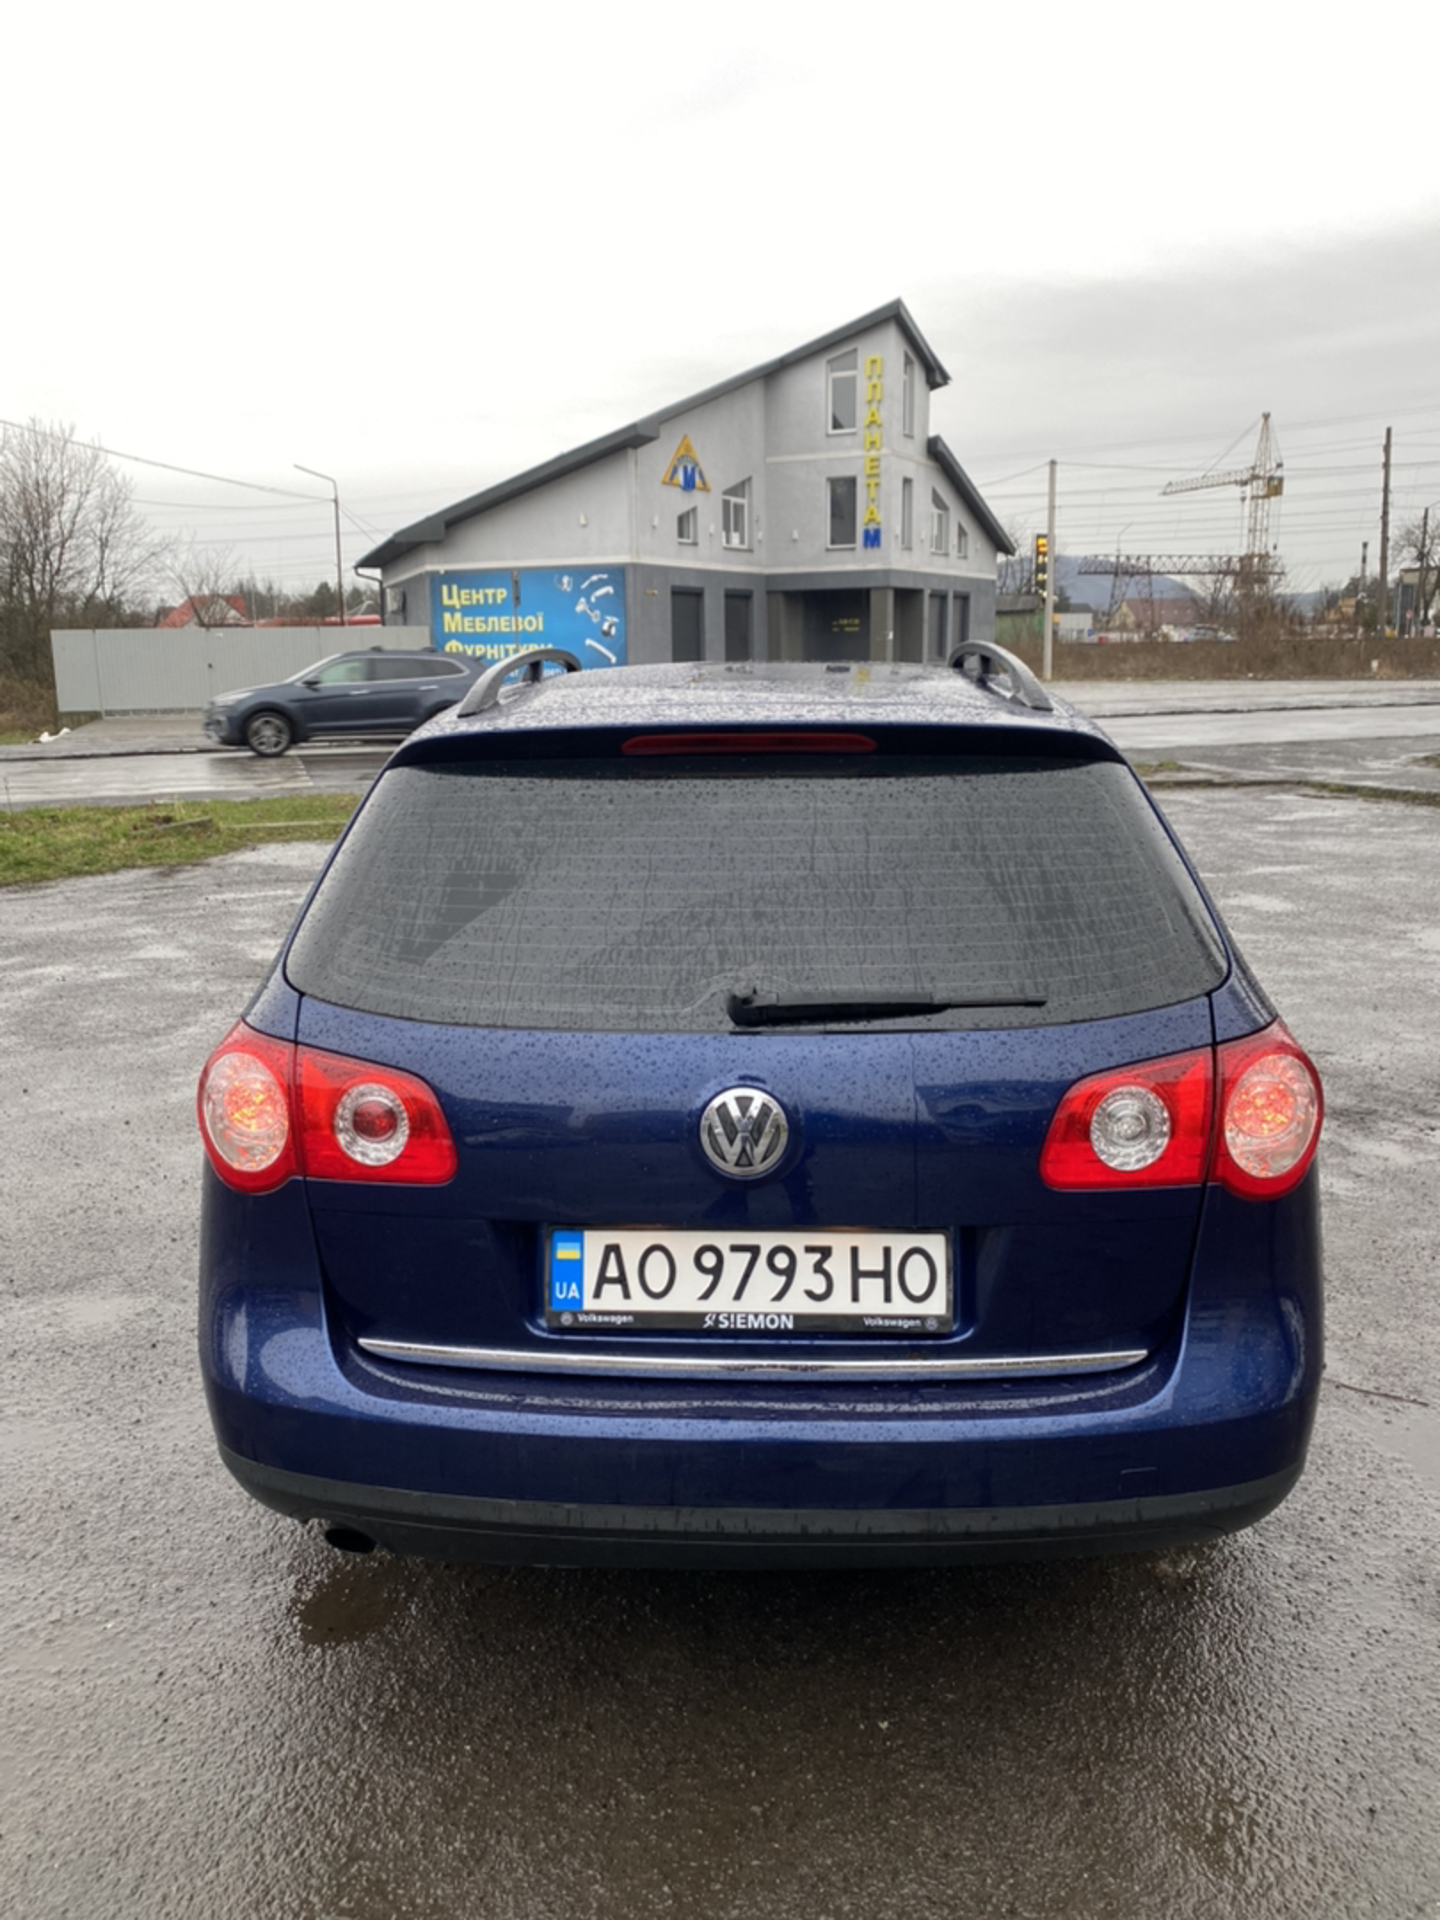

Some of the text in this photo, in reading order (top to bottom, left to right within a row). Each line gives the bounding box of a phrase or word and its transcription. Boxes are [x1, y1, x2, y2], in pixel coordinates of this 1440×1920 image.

[693, 1244, 834, 1302] 9793
[555, 1281, 580, 1299] UA
[577, 1313, 634, 1325] Volkswagen
[863, 1317, 921, 1328] Volkswagen
